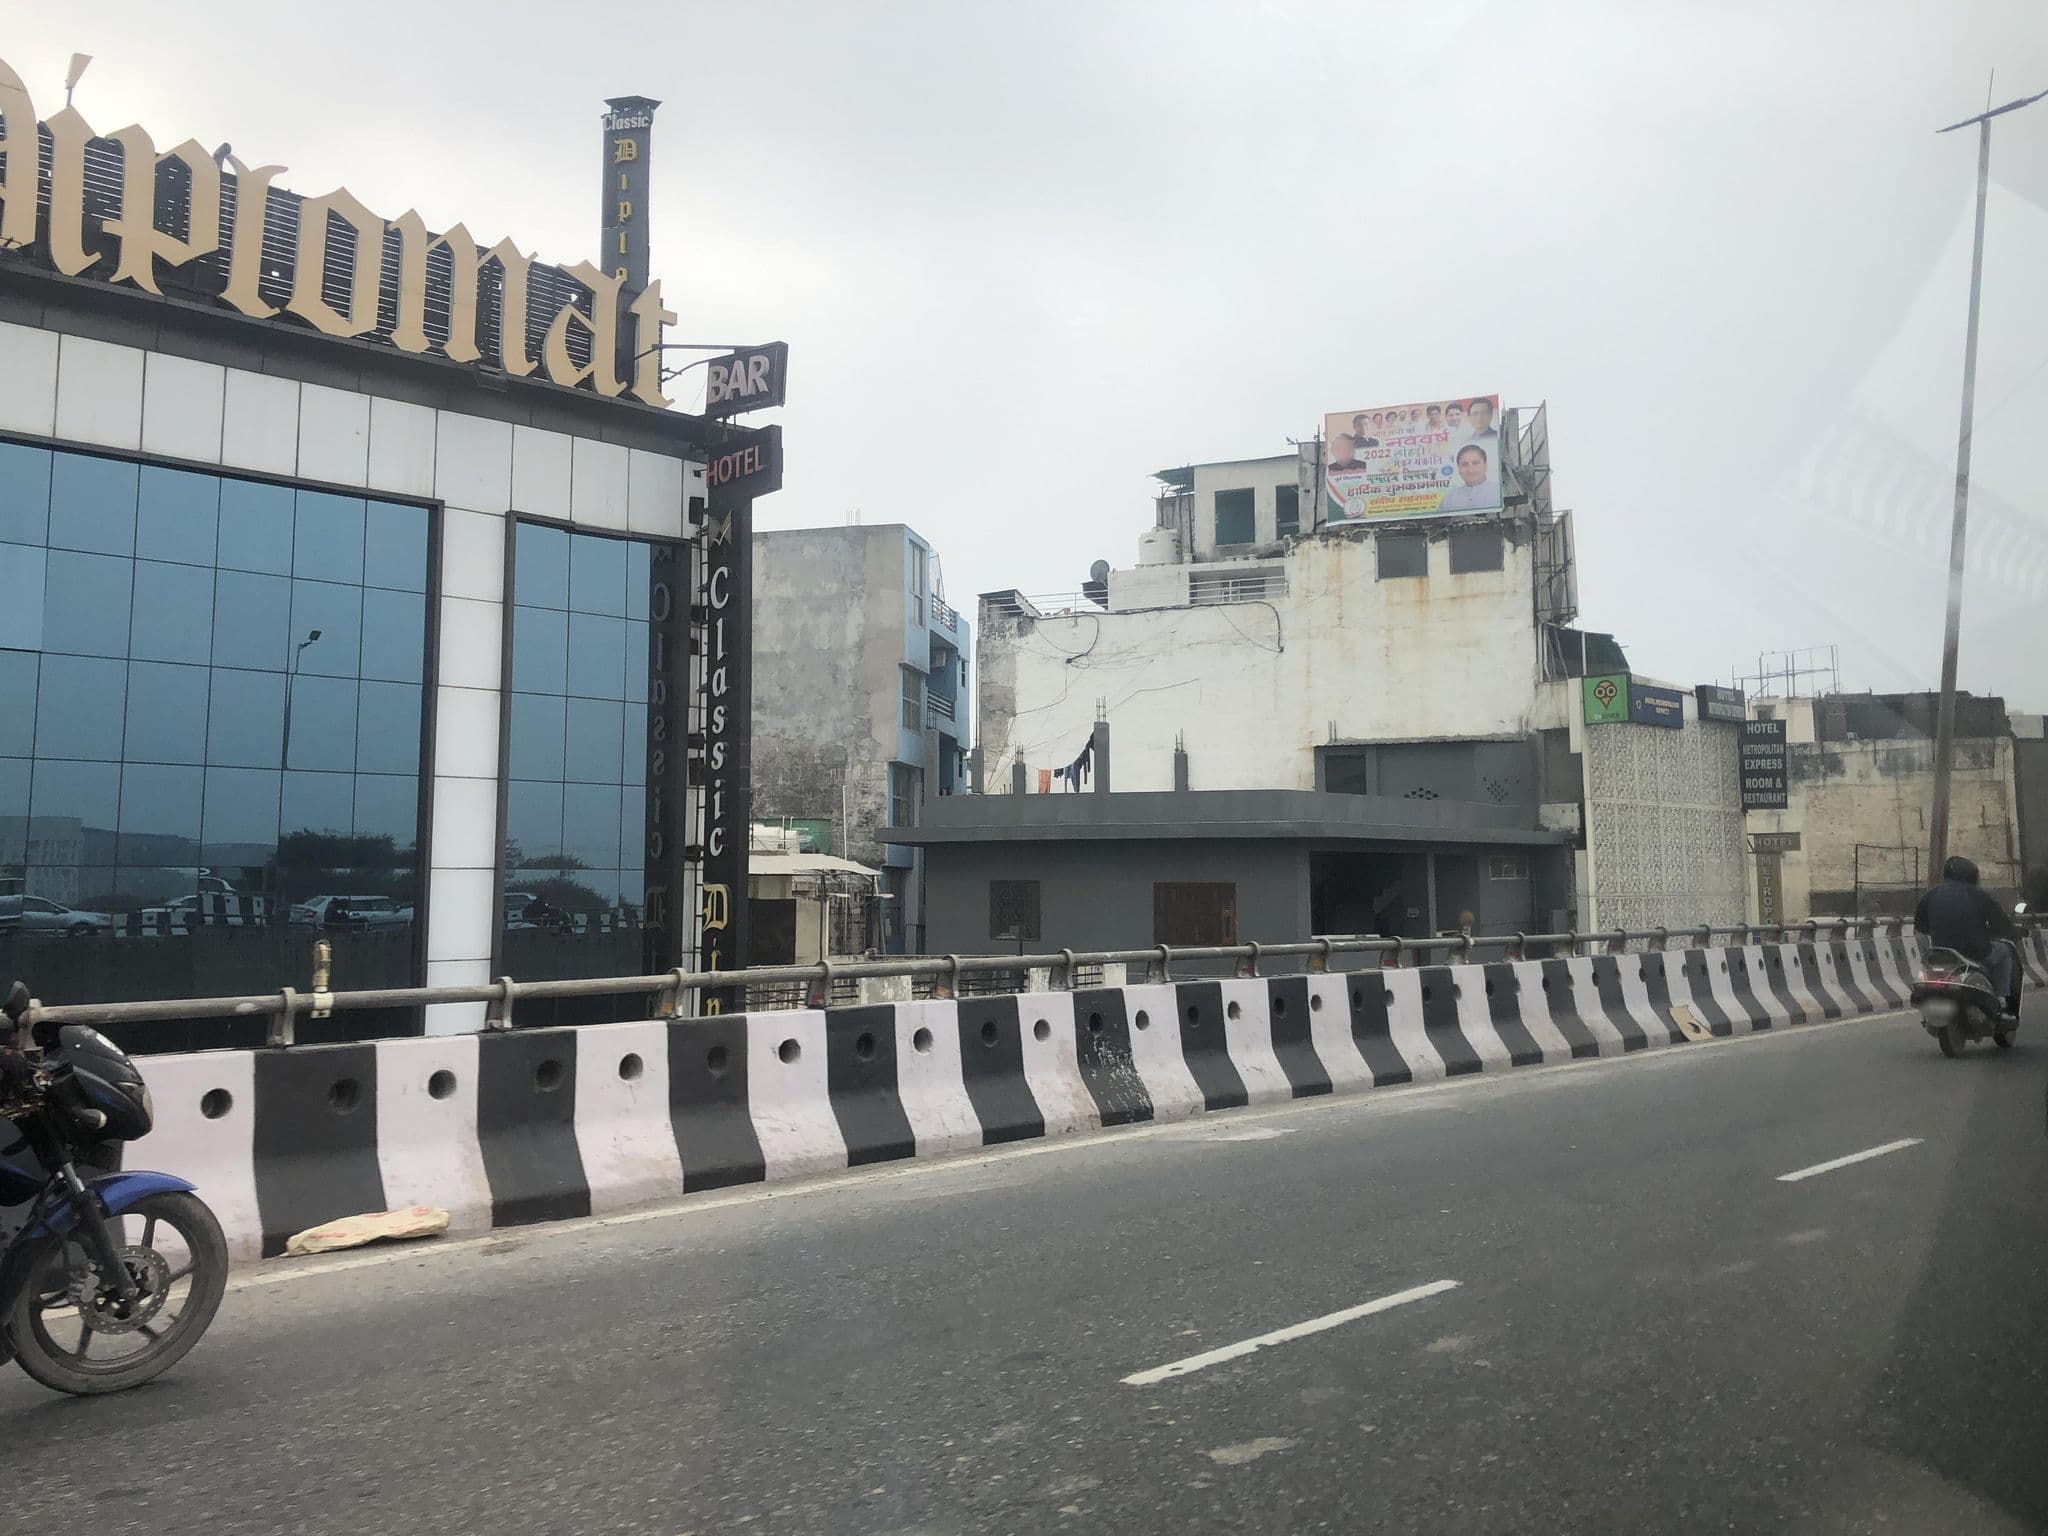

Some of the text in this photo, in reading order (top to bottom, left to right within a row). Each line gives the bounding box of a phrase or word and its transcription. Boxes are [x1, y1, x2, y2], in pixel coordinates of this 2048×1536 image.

[602, 111, 650, 131] Classic
[708, 355, 769, 403] BAR
[1364, 449, 1391, 460] 2022
[706, 445, 764, 487] HOTEL
[1347, 484, 1381, 497] हार्दिक
[709, 566, 729, 857] Classic
[1746, 722, 1779, 734] HOTEL
[1744, 758, 1783, 770] EXPRESS
[1745, 777, 1783, 789] ROOM &
[1743, 792, 1786, 803] RESTAURANT
